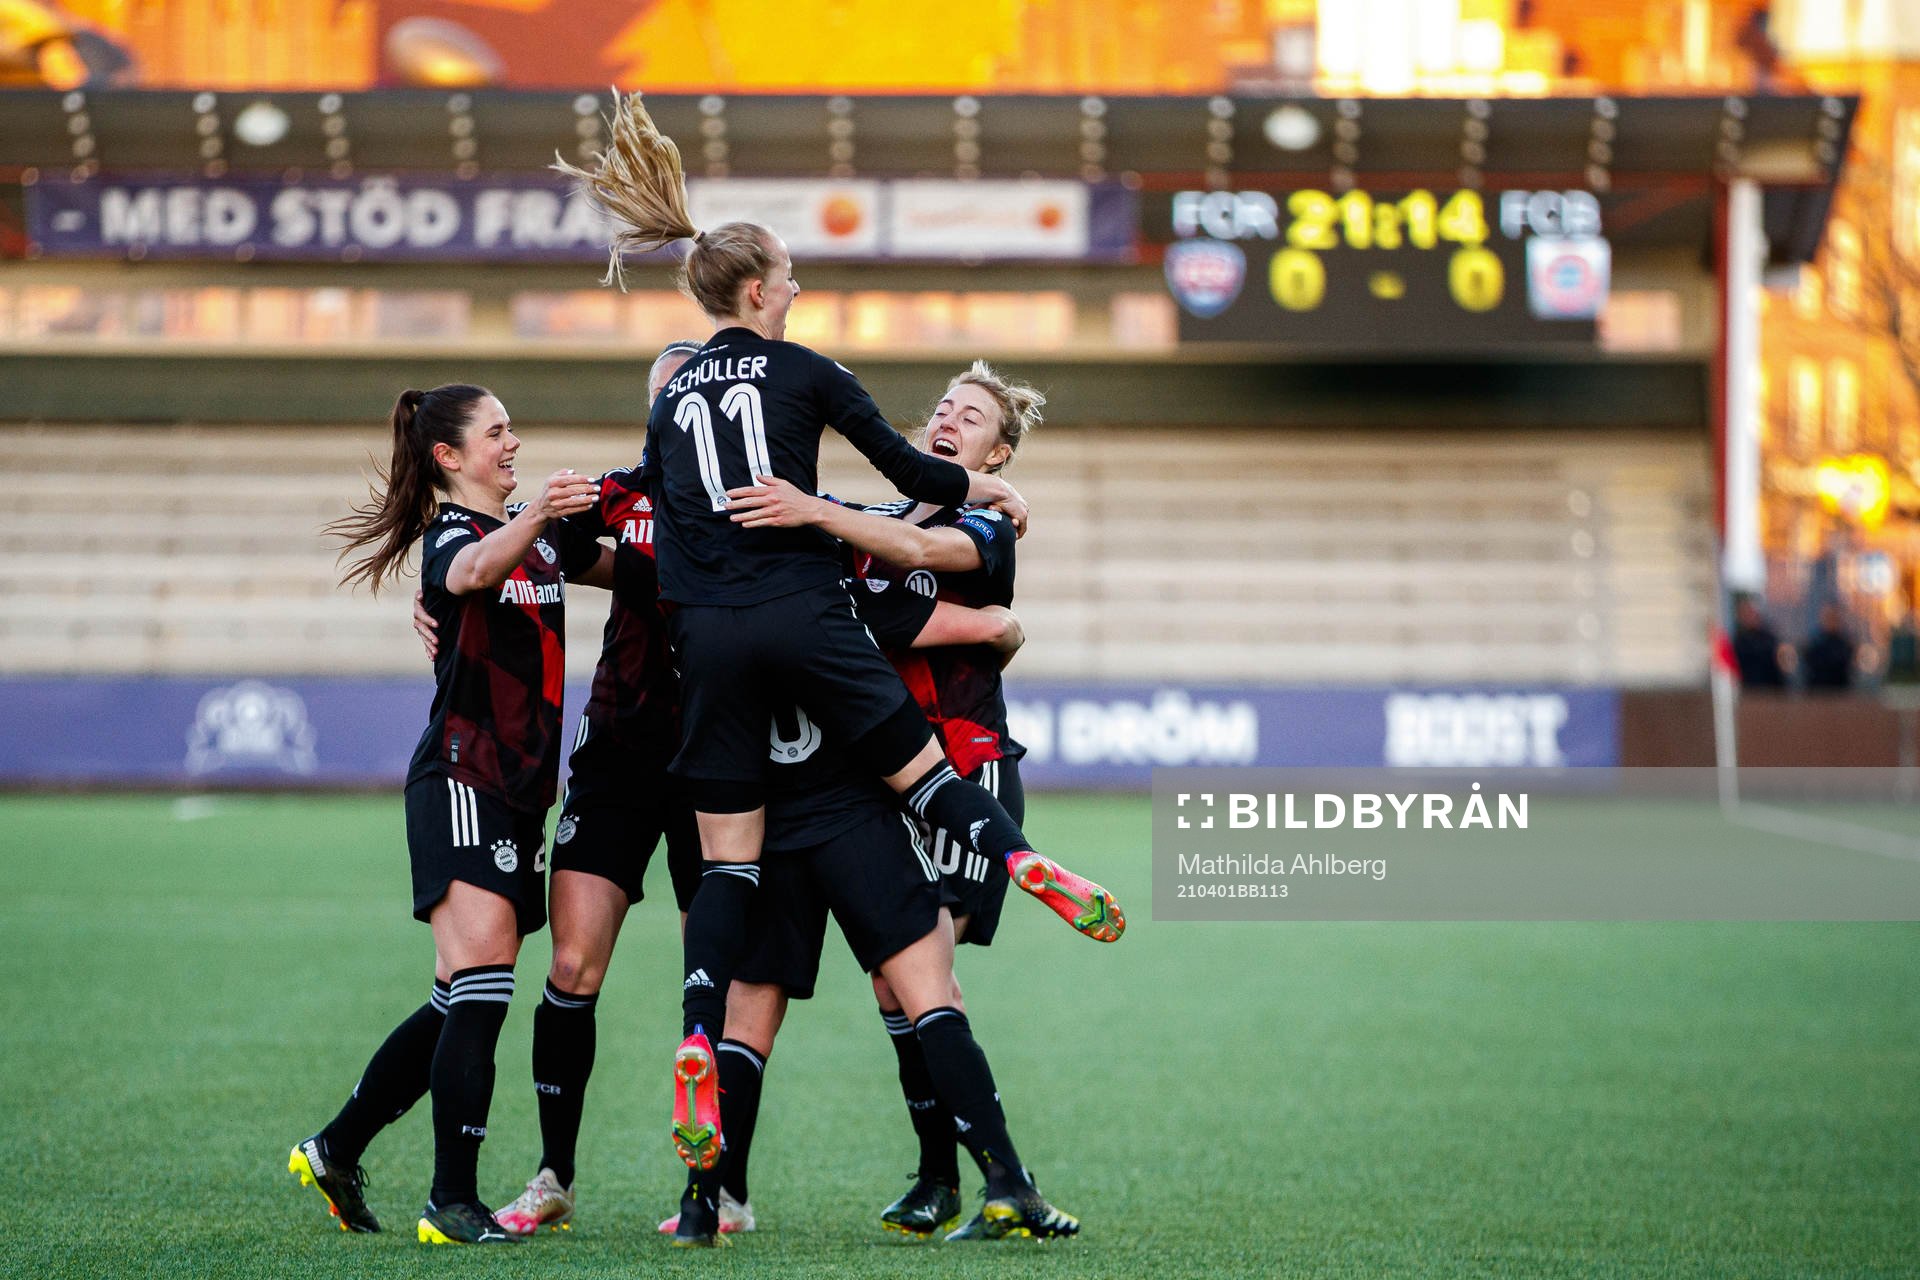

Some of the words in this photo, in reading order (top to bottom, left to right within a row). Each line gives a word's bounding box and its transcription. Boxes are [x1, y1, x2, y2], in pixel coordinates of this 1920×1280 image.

[101, 186, 256, 246] MED
[271, 176, 460, 247] STÖD
[1172, 190, 1279, 240] FCR
[1287, 189, 1489, 250] 21:14
[1500, 190, 1602, 239] FCB
[1269, 245, 1327, 312] 0
[1448, 245, 1505, 312] 0
[666, 355, 768, 398] SCHÜLLER
[673, 382, 774, 512] 11
[620, 519, 654, 543] All
[499, 579, 561, 604] Allianz
[1058, 688, 1259, 766] DRÖM
